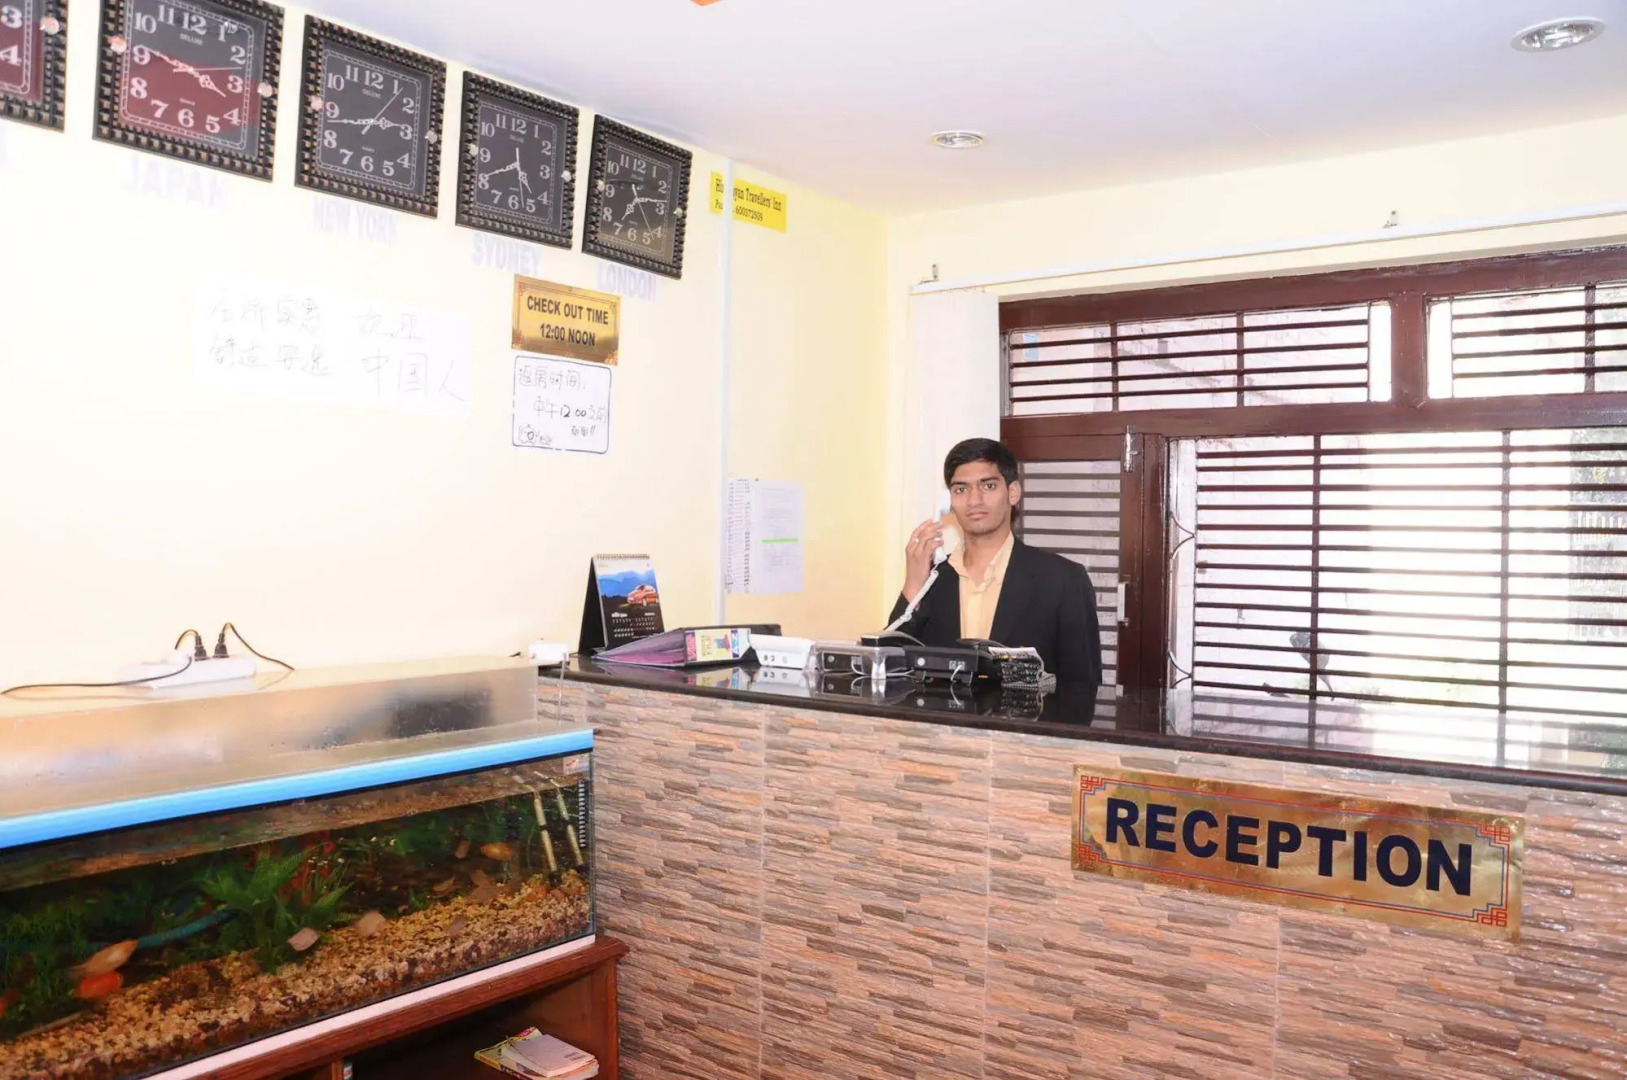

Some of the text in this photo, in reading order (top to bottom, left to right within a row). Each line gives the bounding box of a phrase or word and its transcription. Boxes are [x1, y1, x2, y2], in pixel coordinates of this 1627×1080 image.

[1, 5, 23, 29] 3
[134, 12, 157, 34] 10
[158, 4, 175, 26] 11
[181, 12, 207, 36] 12
[218, 24, 226, 42] 1
[0, 45, 22, 66] 4
[132, 45, 151, 66] 9
[230, 45, 247, 65] 2
[327, 72, 345, 91] 10
[345, 65, 359, 83] 11
[364, 70, 385, 90] 12
[130, 77, 148, 100] 8
[227, 75, 244, 94] 3
[393, 79, 399, 94] 1
[150, 99, 169, 119] 7
[325, 101, 340, 119] 9
[402, 97, 415, 115] 2
[177, 108, 195, 128] 6
[205, 115, 221, 134] 5
[223, 107, 242, 126] 4
[495, 113, 507, 129] 11
[399, 124, 413, 141] 3
[480, 121, 496, 138] 10
[511, 117, 527, 135] 12
[533, 124, 540, 139] 1
[323, 130, 338, 149] 8
[541, 140, 552, 156] 2
[339, 149, 354, 165] 7
[360, 155, 374, 172] 6
[396, 152, 411, 169] 4
[479, 147, 491, 163] 9
[619, 153, 630, 169] 11
[382, 160, 395, 177] 5
[539, 164, 551, 180] 3
[607, 160, 620, 176] 10
[632, 158, 647, 175] 12
[652, 165, 658, 179] 1
[478, 173, 490, 190] 8
[658, 180, 668, 194] 2
[490, 189, 503, 205] 7
[537, 190, 549, 206] 4
[605, 183, 616, 198] 9
[508, 194, 520, 210] 6
[525, 198, 536, 213] 5
[655, 202, 665, 216] 3
[311, 195, 351, 236] NEW
[602, 206, 613, 222] 8
[612, 221, 624, 236] 7
[627, 227, 637, 242] 6
[652, 225, 663, 239] 4
[642, 231, 651, 245] 5
[471, 231, 543, 275] SYDNEY
[597, 262, 658, 302] LONDON
[527, 295, 609, 325] CHECK OUT TIME
[540, 323, 596, 346] 12:00 NOON
[361, 346, 466, 402] 中国人
[1106, 797, 1472, 897] RECEPTION
